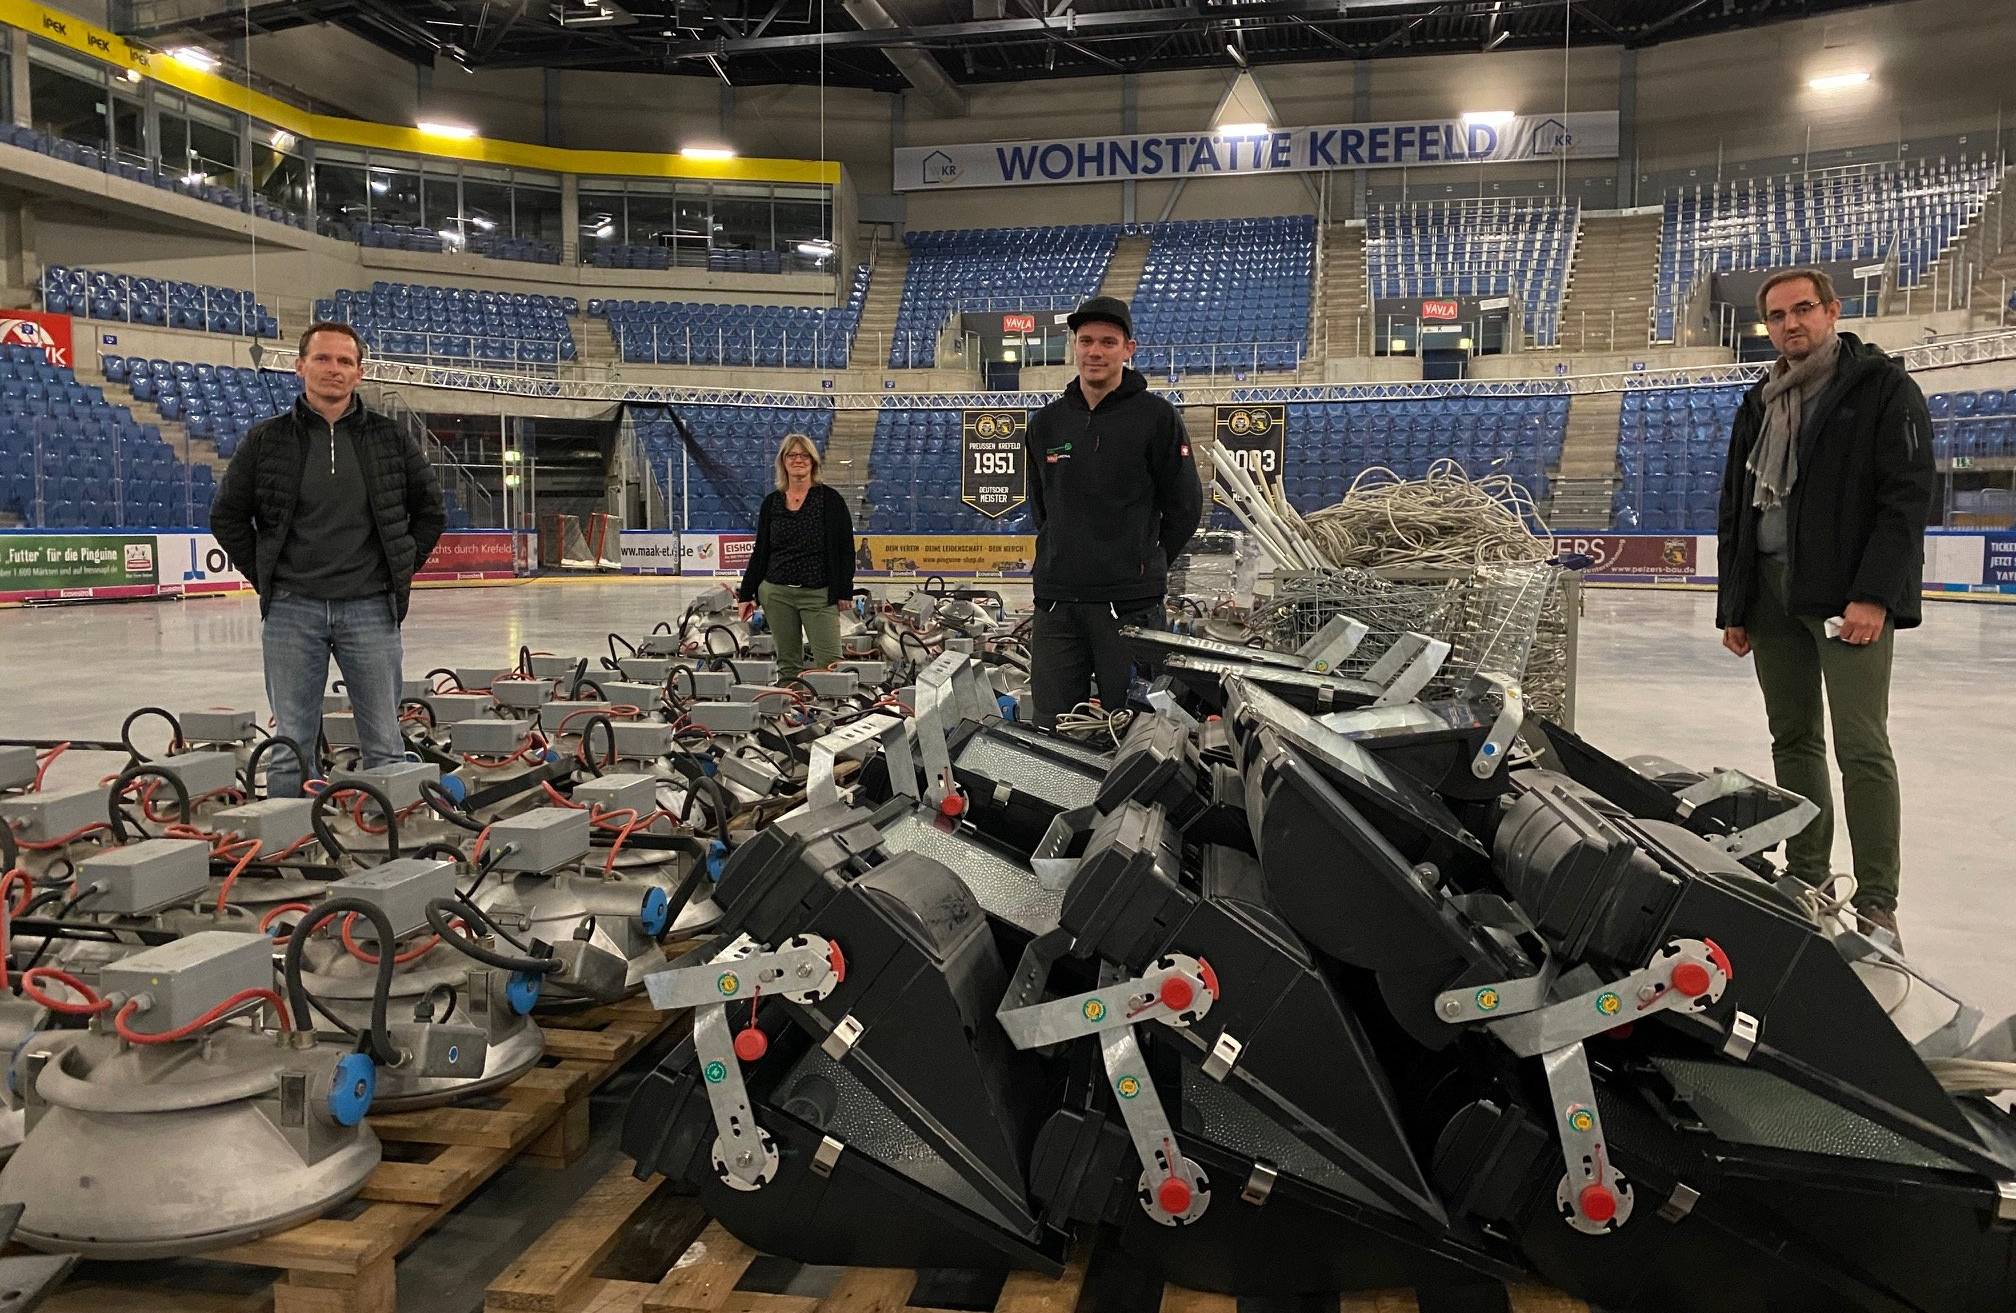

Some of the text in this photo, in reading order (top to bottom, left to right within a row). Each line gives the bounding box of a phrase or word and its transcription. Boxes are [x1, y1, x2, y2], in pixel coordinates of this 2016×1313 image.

[997, 123, 1498, 181] WOHNSTÄTTE KREFELD
[1425, 303, 1455, 316] YAYLA
[1006, 318, 1032, 329] YAYLA
[969, 442, 1021, 450] PREUSSEN KREFELD
[974, 452, 1016, 474] 1951
[979, 486, 1009, 494] DEUTSCHER
[980, 494, 1008, 503] MEISTER
[453, 544, 479, 555] durch
[481, 543, 512, 554] Krefeld
[725, 543, 755, 553] EISHO
[47, 548, 62, 562] für
[65, 548, 78, 561] die
[81, 547, 118, 563] Pinguine
[1611, 566, 1695, 574] www.pelzers-bau.de
